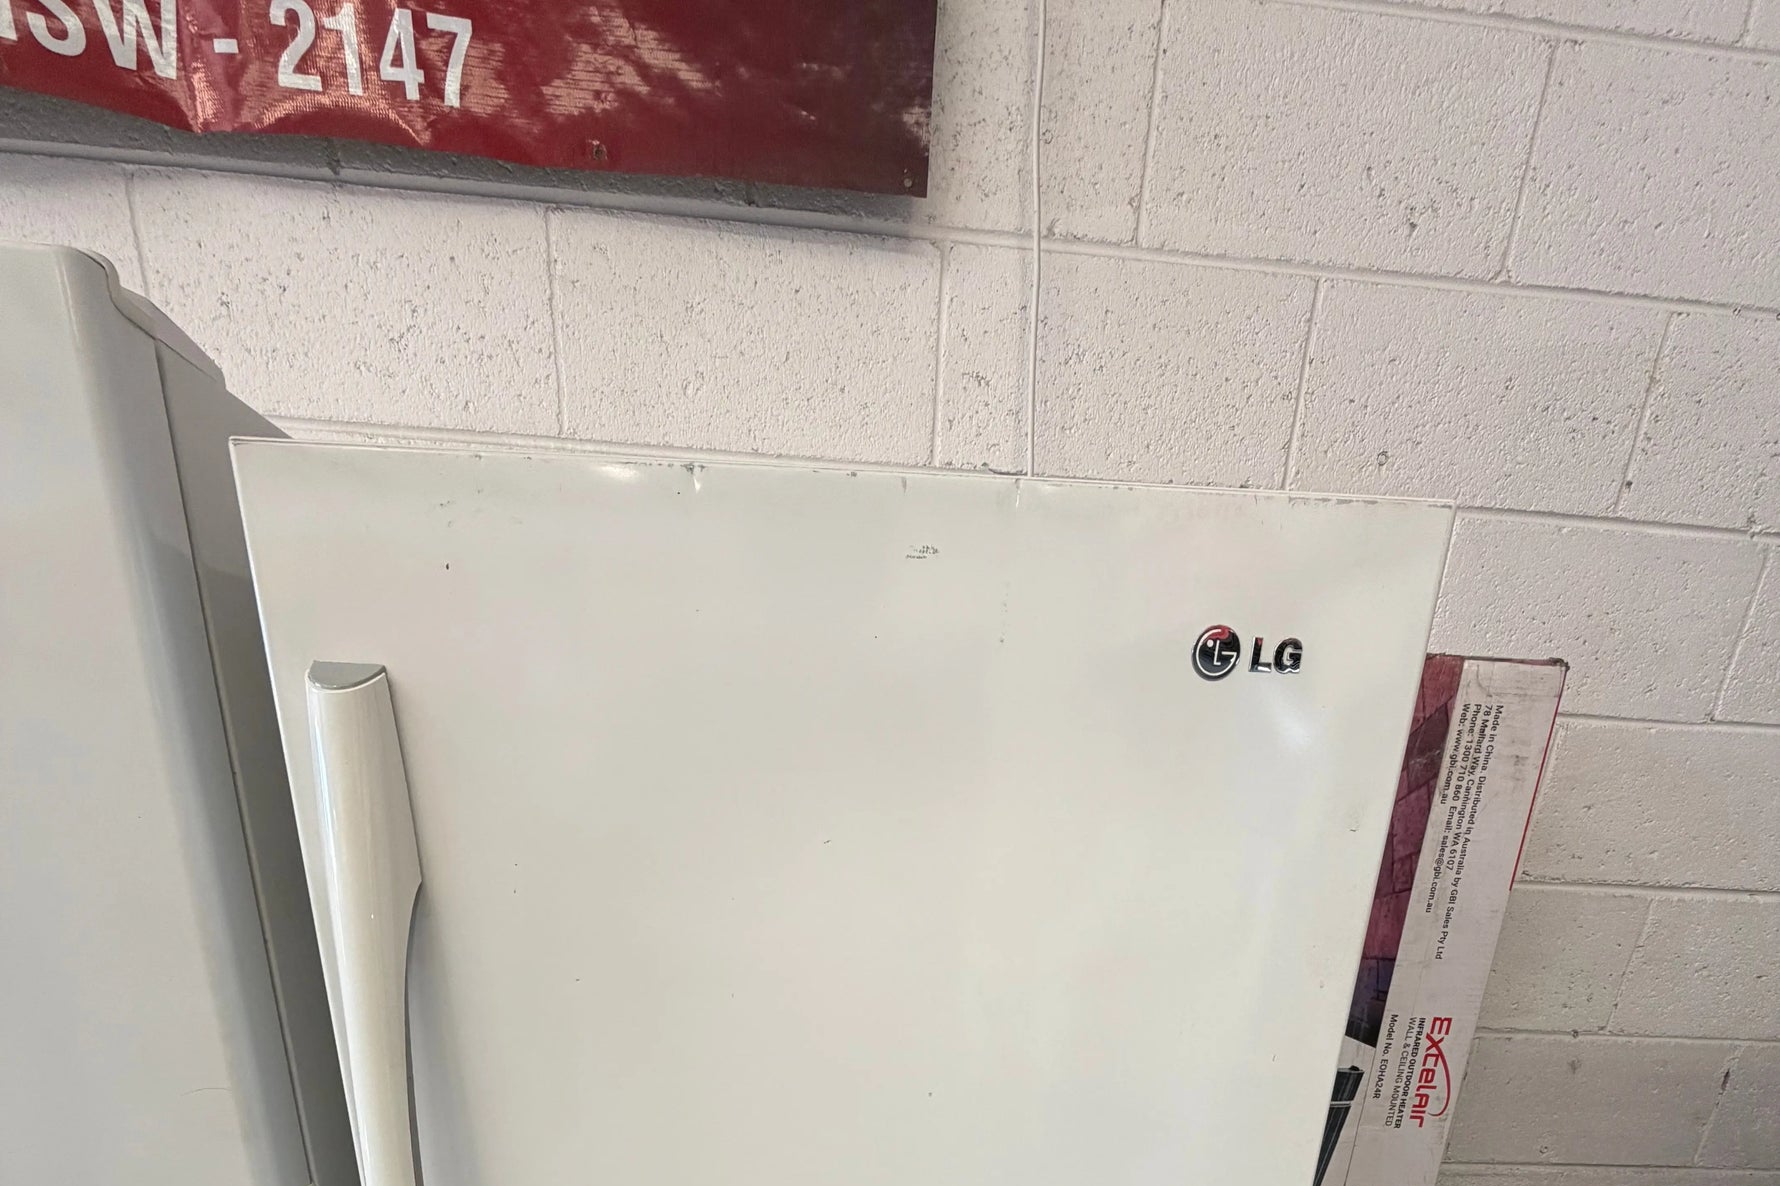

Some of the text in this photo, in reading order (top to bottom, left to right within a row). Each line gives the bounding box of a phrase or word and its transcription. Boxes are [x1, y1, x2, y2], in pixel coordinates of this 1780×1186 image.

[269, 0, 472, 108] 2147
[1249, 637, 1303, 673] LG
[1490, 704, 1503, 732] Made
[1438, 702, 1470, 805] Web: www.gbi.com.au
[1480, 744, 1494, 774] China.
[1445, 704, 1492, 870] 78 Mallard Way, Cannington WA 6107
[1467, 775, 1486, 825] Distributed
[1423, 702, 1481, 913] Phone: 1300 710 860 Email: sales@gbi.com.au
[1455, 837, 1470, 875] Australia
[1448, 888, 1458, 904] GBI
[1450, 876, 1461, 887] by
[1442, 905, 1454, 929] Sales
[1434, 945, 1444, 960] Ltd
[1437, 930, 1448, 944] Pty
[1385, 1013, 1398, 1041] Model
[1404, 1016, 1416, 1041] WALL
[1381, 1041, 1392, 1057] No.
[1393, 1016, 1426, 1129] INFRARED OUTDOOR HEATER
[1394, 1050, 1409, 1084] CEILING
[1384, 1085, 1400, 1127] MOUNTED
